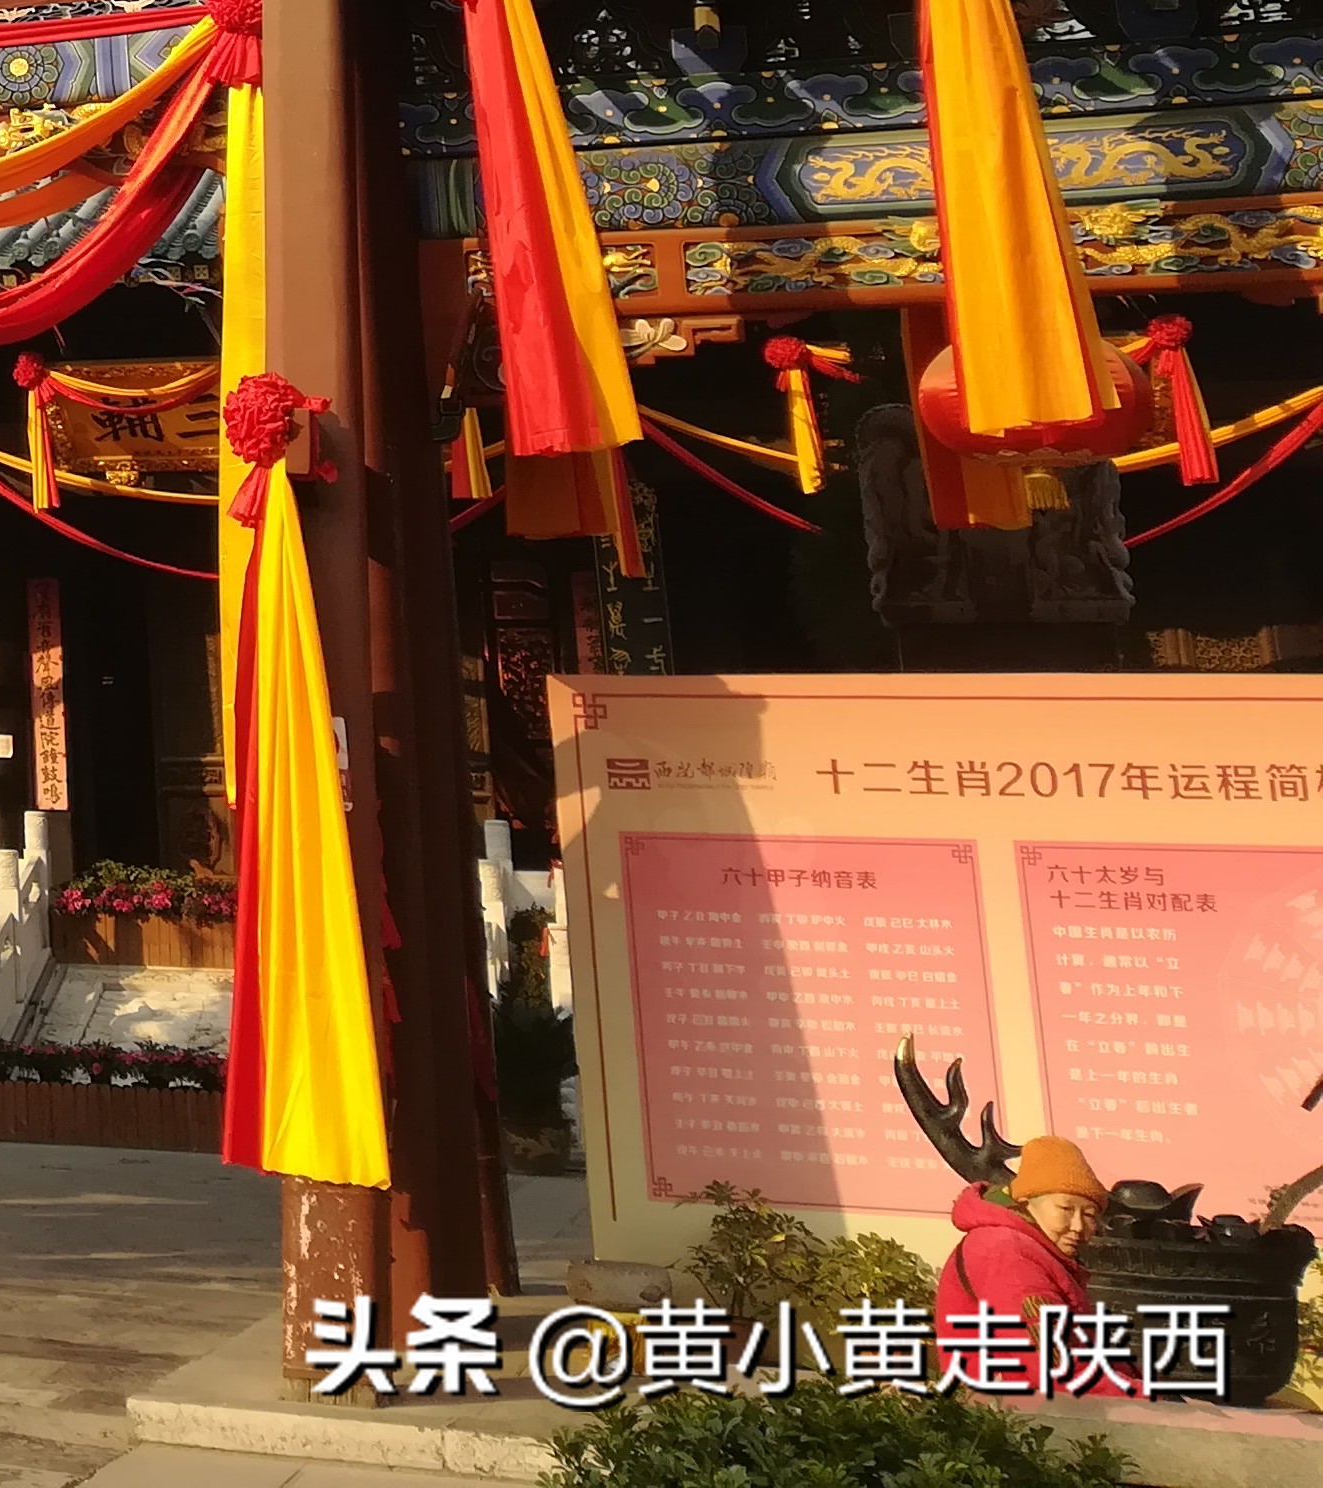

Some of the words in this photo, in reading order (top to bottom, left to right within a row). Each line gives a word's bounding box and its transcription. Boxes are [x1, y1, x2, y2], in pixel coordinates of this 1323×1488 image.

[816, 758, 1323, 802] 十二生肖2017年运程简
[721, 866, 879, 890] 六十甲子纳音表
[1047, 864, 1165, 887] 六十太岁与
[1050, 889, 1219, 913] 十二生肖对配表
